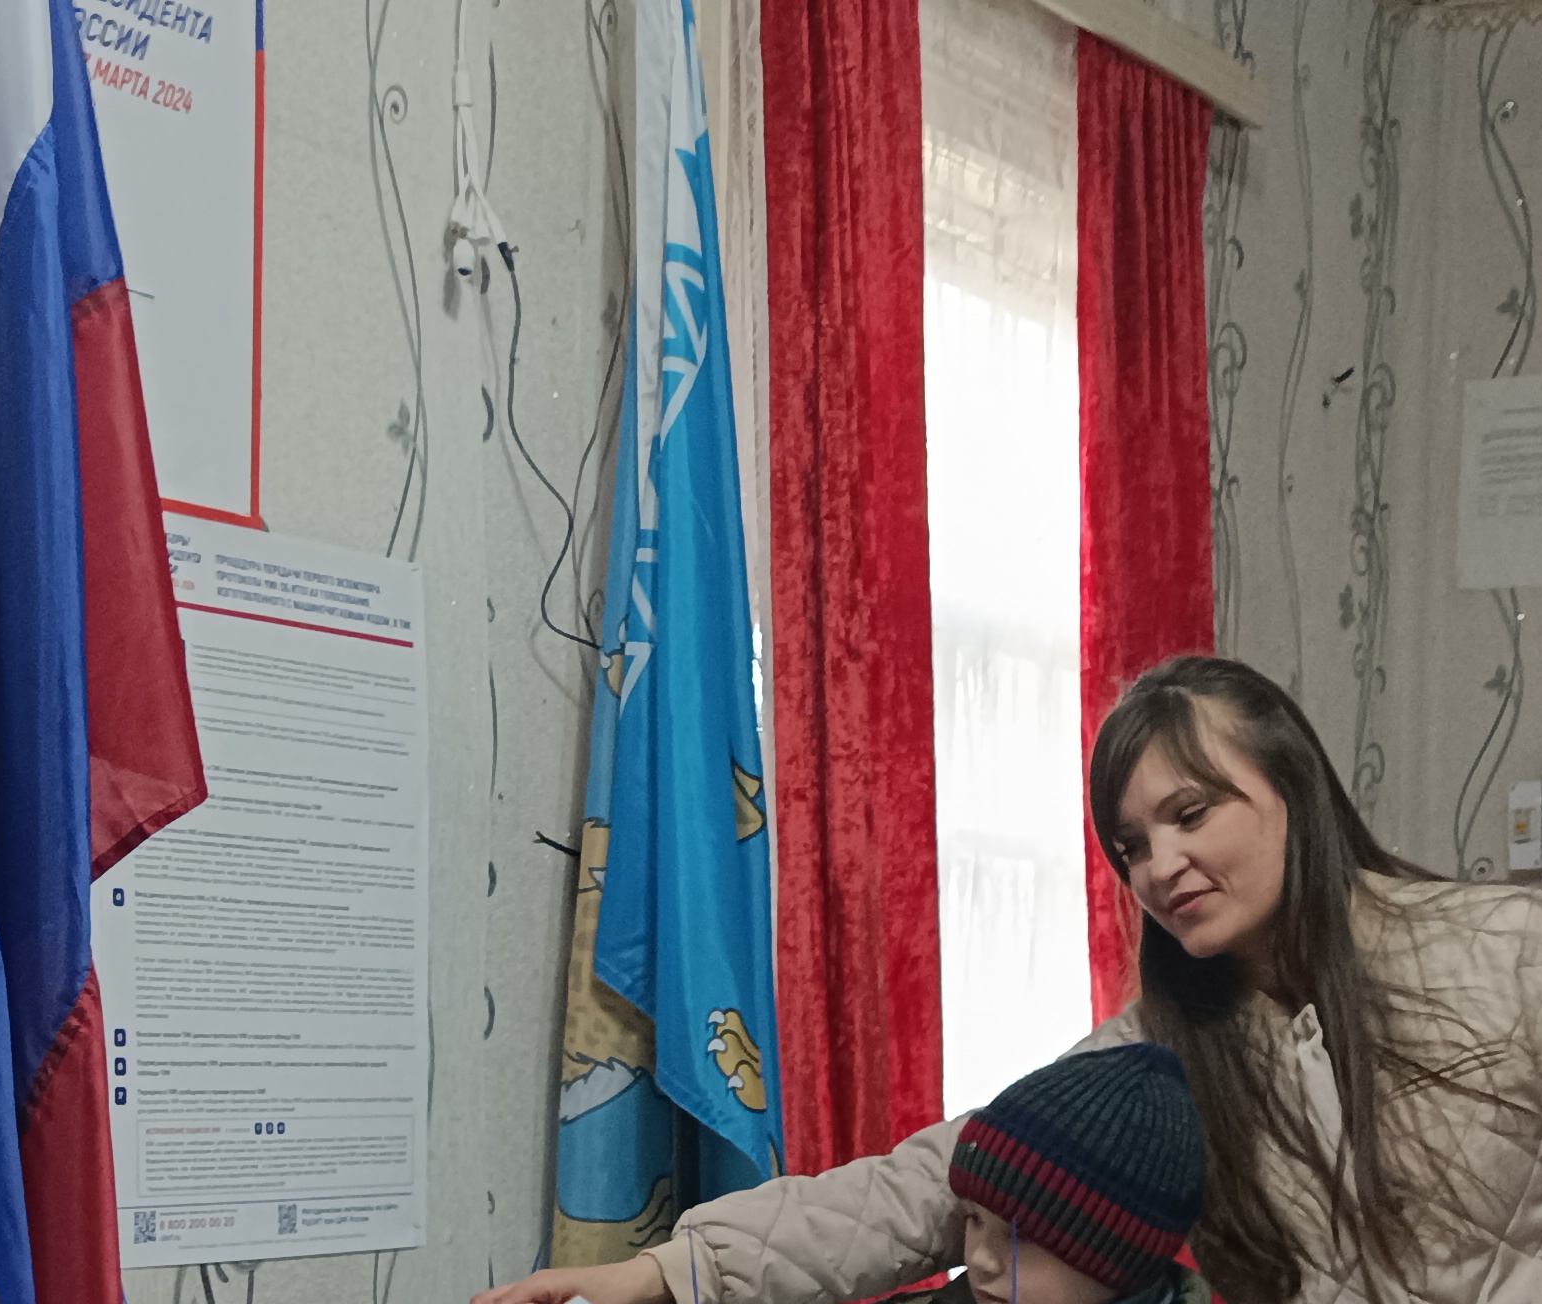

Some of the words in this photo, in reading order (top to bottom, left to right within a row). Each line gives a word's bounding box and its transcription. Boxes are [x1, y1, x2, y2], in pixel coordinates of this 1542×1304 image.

[73, 7, 151, 61] ОССИИ
[99, 0, 214, 44] ИДЕНТА
[92, 57, 151, 100] МАРТА
[151, 80, 193, 114] 2024
